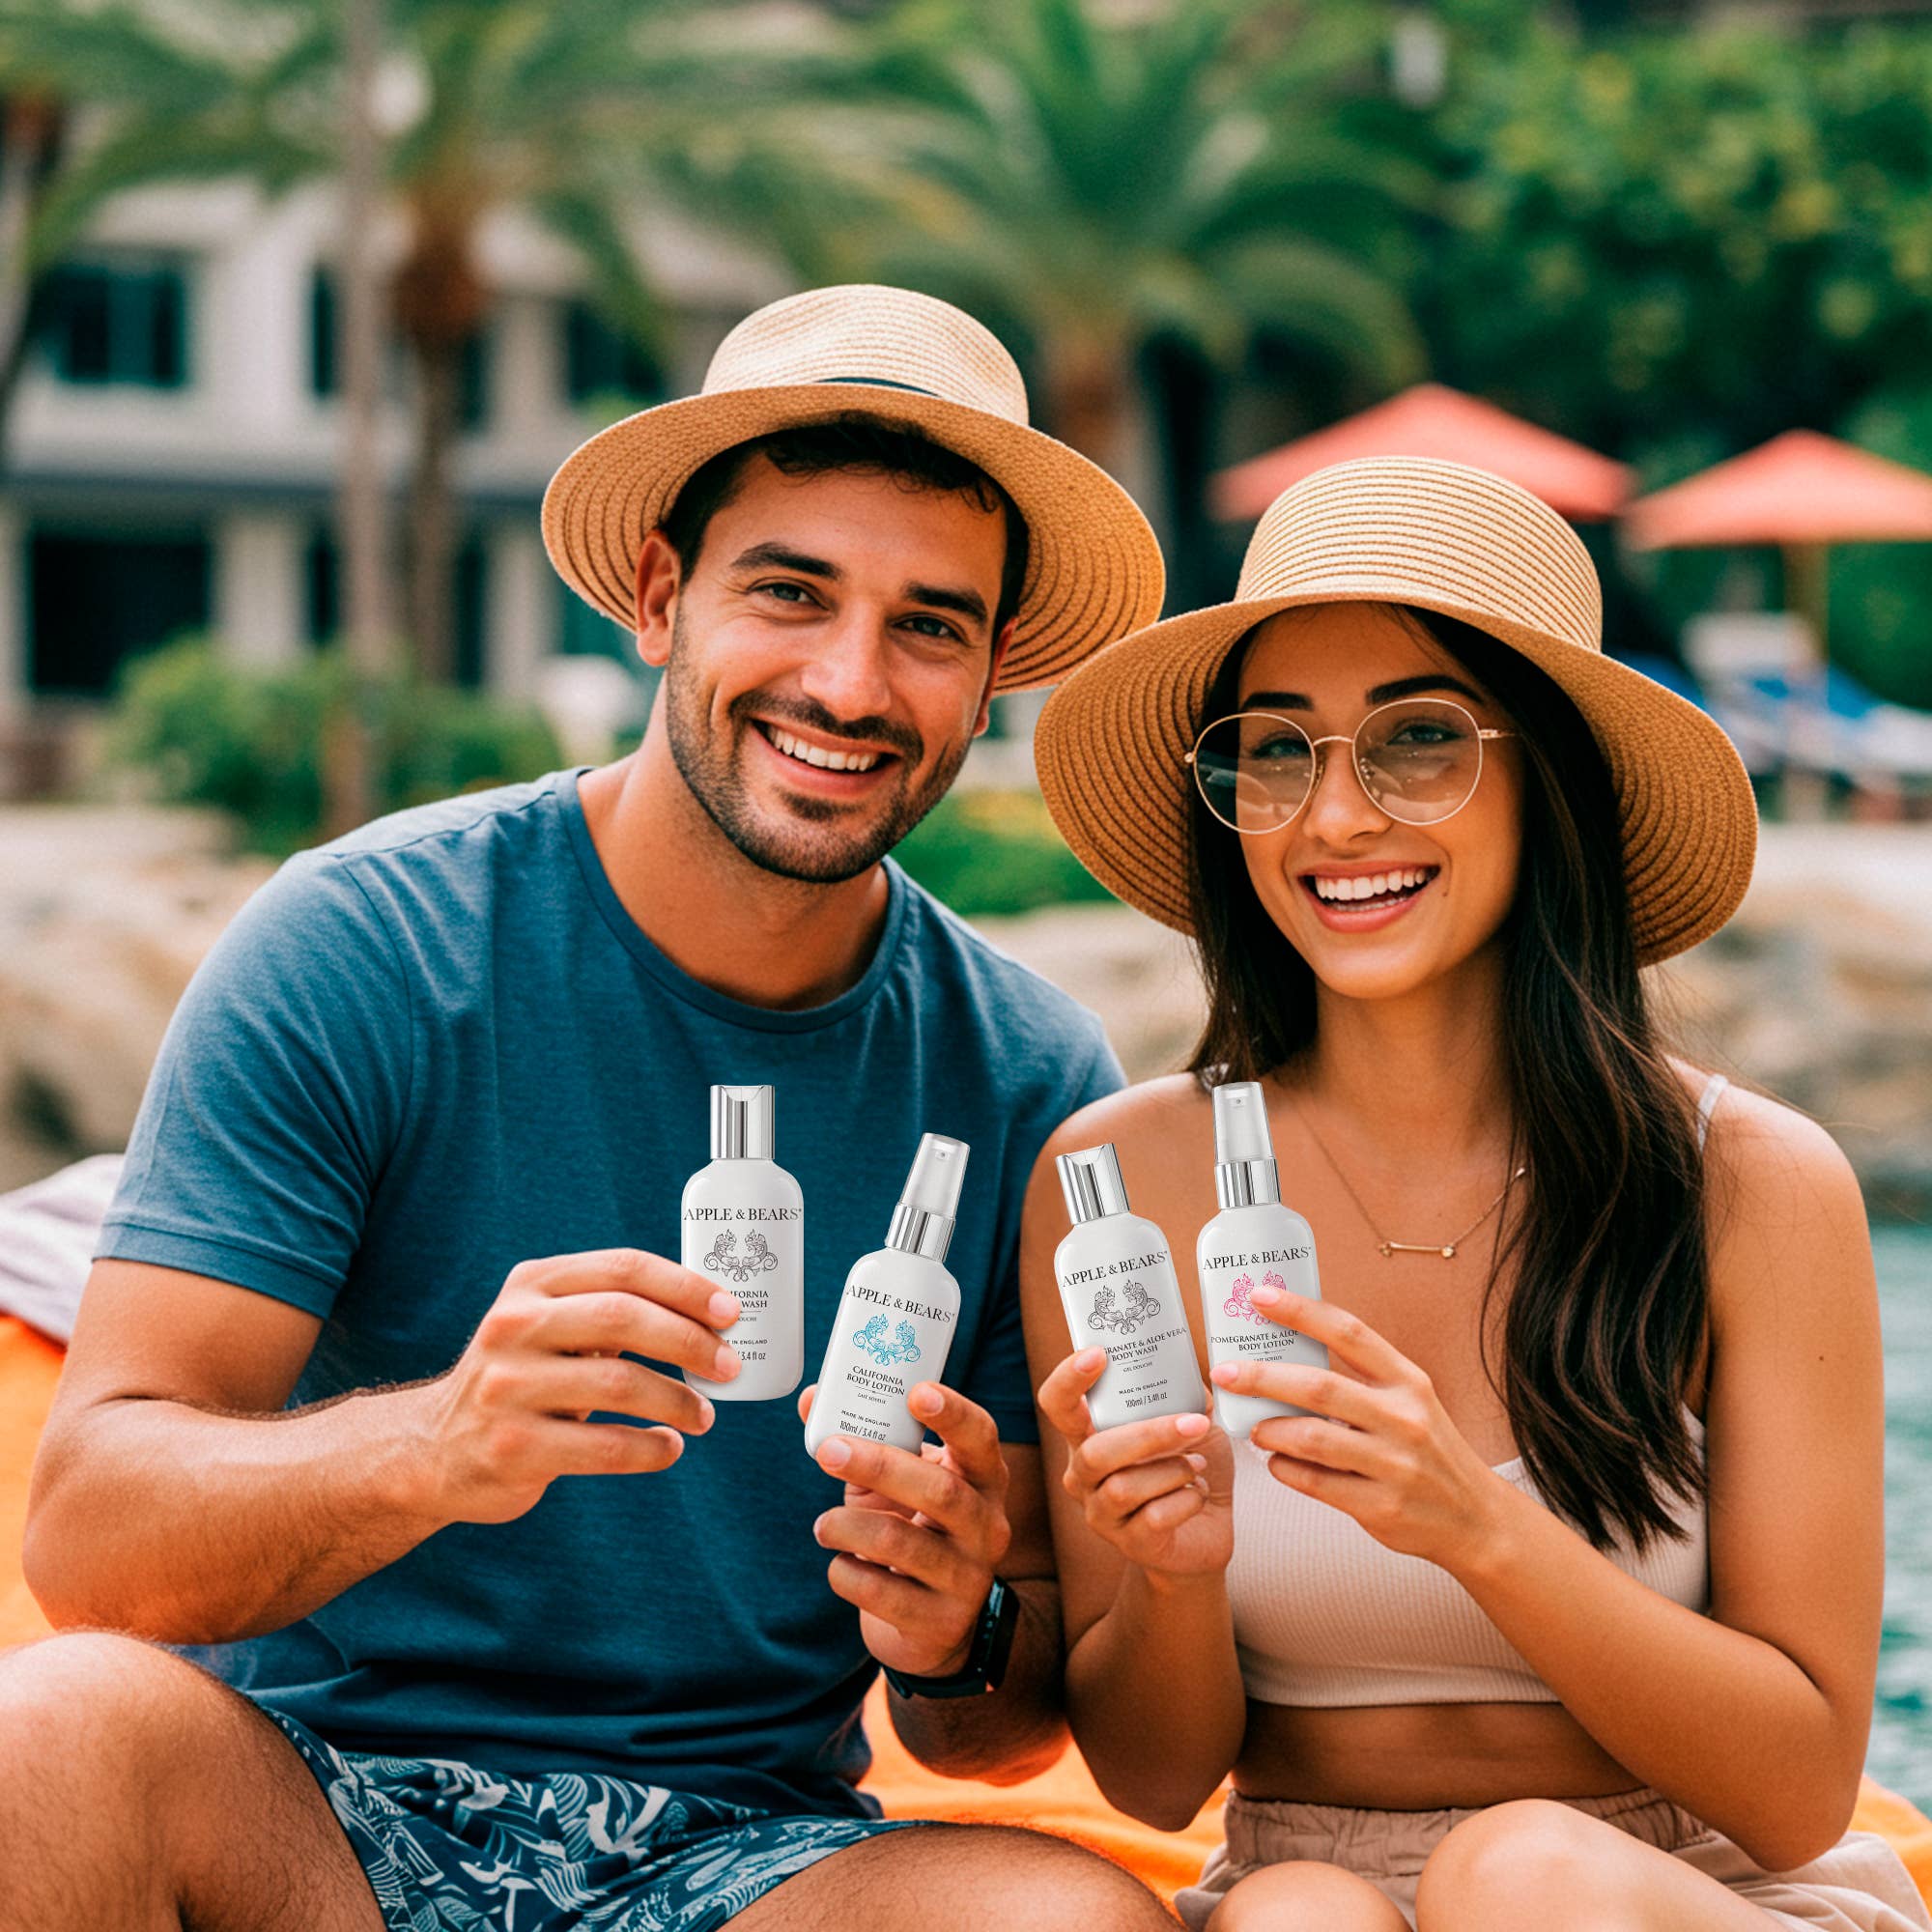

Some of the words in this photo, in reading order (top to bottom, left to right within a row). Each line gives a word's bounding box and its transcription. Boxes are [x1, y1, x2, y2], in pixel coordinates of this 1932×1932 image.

[683, 1208, 732, 1221] APPLE
[736, 1208, 745, 1221] &
[1203, 1253, 1248, 1270] APPLE
[1251, 1253, 1260, 1264] &
[1062, 1267, 1107, 1288] APPLE
[1108, 1264, 1119, 1275] &
[730, 1290, 769, 1298] IFORNIA
[845, 1285, 892, 1307] APPLE
[893, 1297, 903, 1310] &
[1104, 1341, 1138, 1354] RANATE
[1146, 1334, 1166, 1346] ALOE
[1166, 1327, 1187, 1338] VERA
[1210, 1332, 1270, 1344] POMEGRANATE
[1279, 1329, 1299, 1338] ALOE
[1238, 1342, 1262, 1351] BODY
[1263, 1338, 1294, 1350] LOTION
[1111, 1350, 1134, 1362] BODY
[1134, 1344, 1158, 1356] WASH
[846, 1373, 870, 1386] BODY
[871, 1380, 905, 1396] LOTION
[852, 1365, 903, 1386] CALIFORNIA
[1142, 1378, 1168, 1390] ENGLAND
[840, 1409, 857, 1418] MADE
[865, 1417, 891, 1428] ENGLAND
